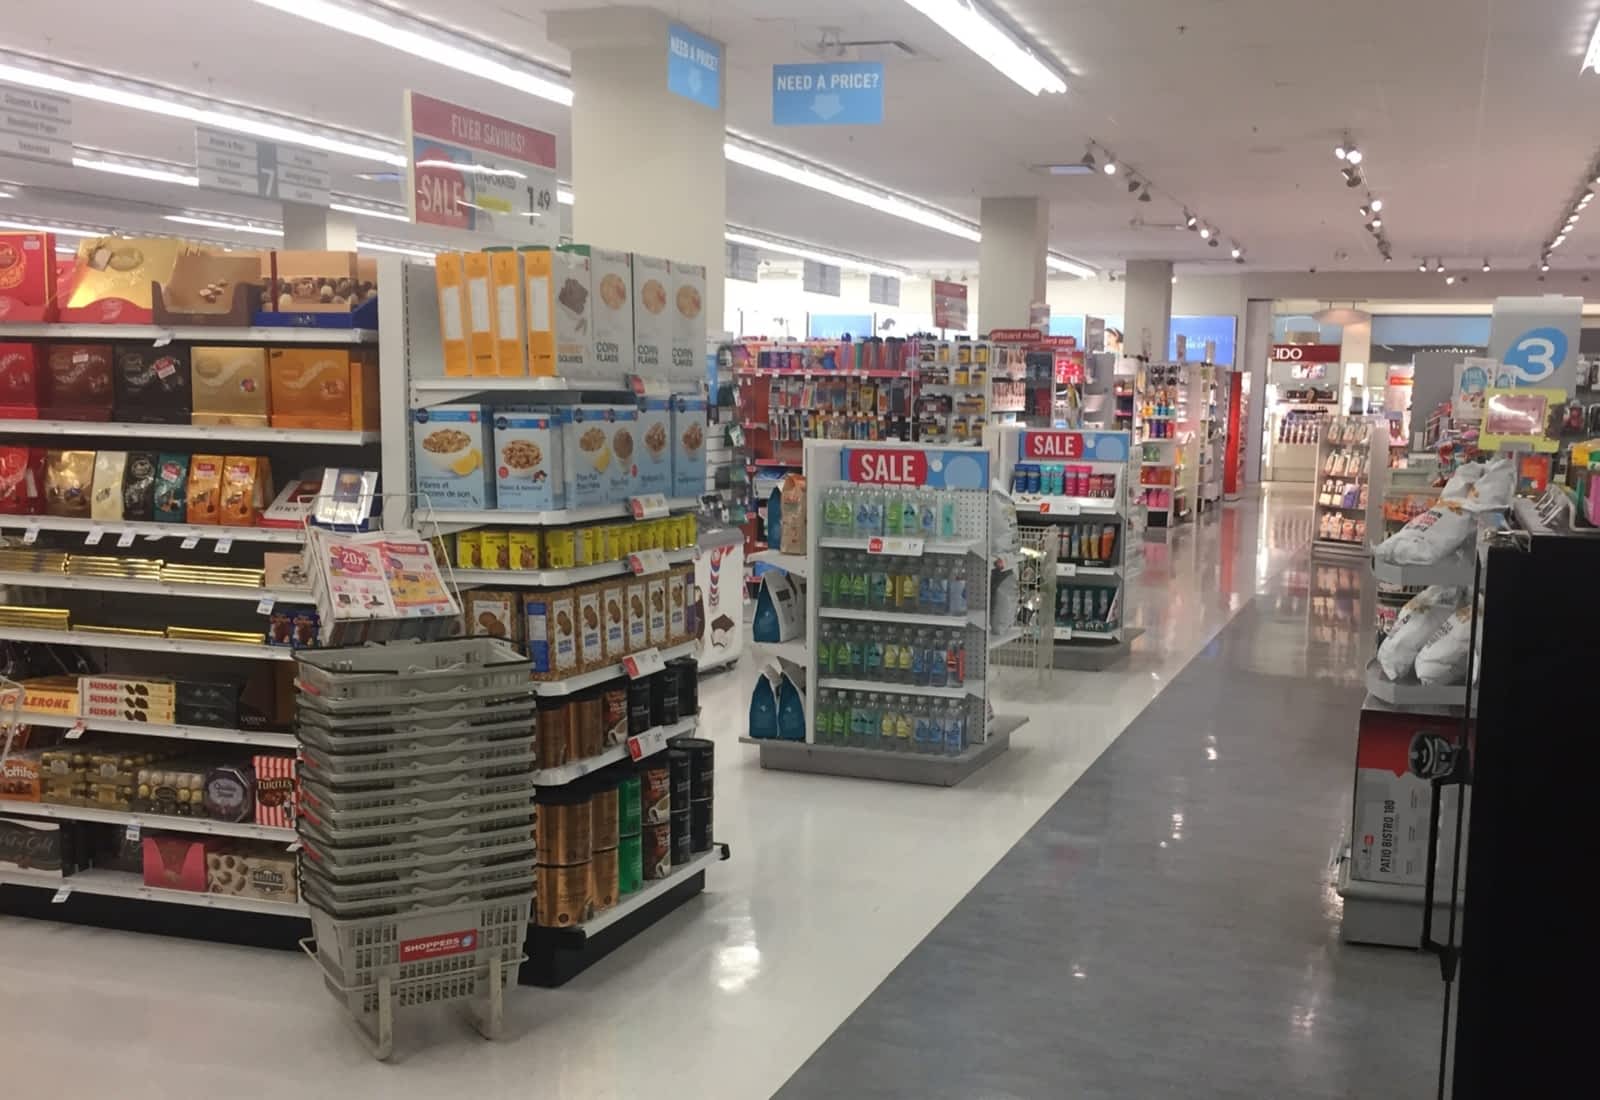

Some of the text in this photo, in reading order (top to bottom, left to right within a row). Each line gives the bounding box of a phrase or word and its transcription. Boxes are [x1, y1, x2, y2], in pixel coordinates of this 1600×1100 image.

[670, 35, 688, 58] NEED
[777, 73, 880, 91] NEED A PRICE?
[451, 114, 526, 151] FLYER SAVINGS!
[261, 167, 275, 196] 7
[421, 174, 463, 216] SALE
[597, 342, 618, 352] CORN
[638, 345, 658, 355] CORN
[672, 348, 693, 358] CORN
[597, 354, 618, 363] FLAKES
[638, 356, 658, 365] FLAKES
[673, 359, 693, 367] FLAKES
[1516, 337, 1555, 382] 3
[1033, 435, 1075, 456] SALE
[860, 454, 916, 482] SALE
[342, 552, 365, 566] 20x
[89, 681, 118, 690] SUISSE
[89, 694, 118, 704] SUISSE
[89, 707, 117, 716] SUISSE
[257, 780, 293, 790] TURTLES
[1379, 799, 1395, 873] PATIO BISTRO 180
[404, 937, 461, 953] SHOPPERS
